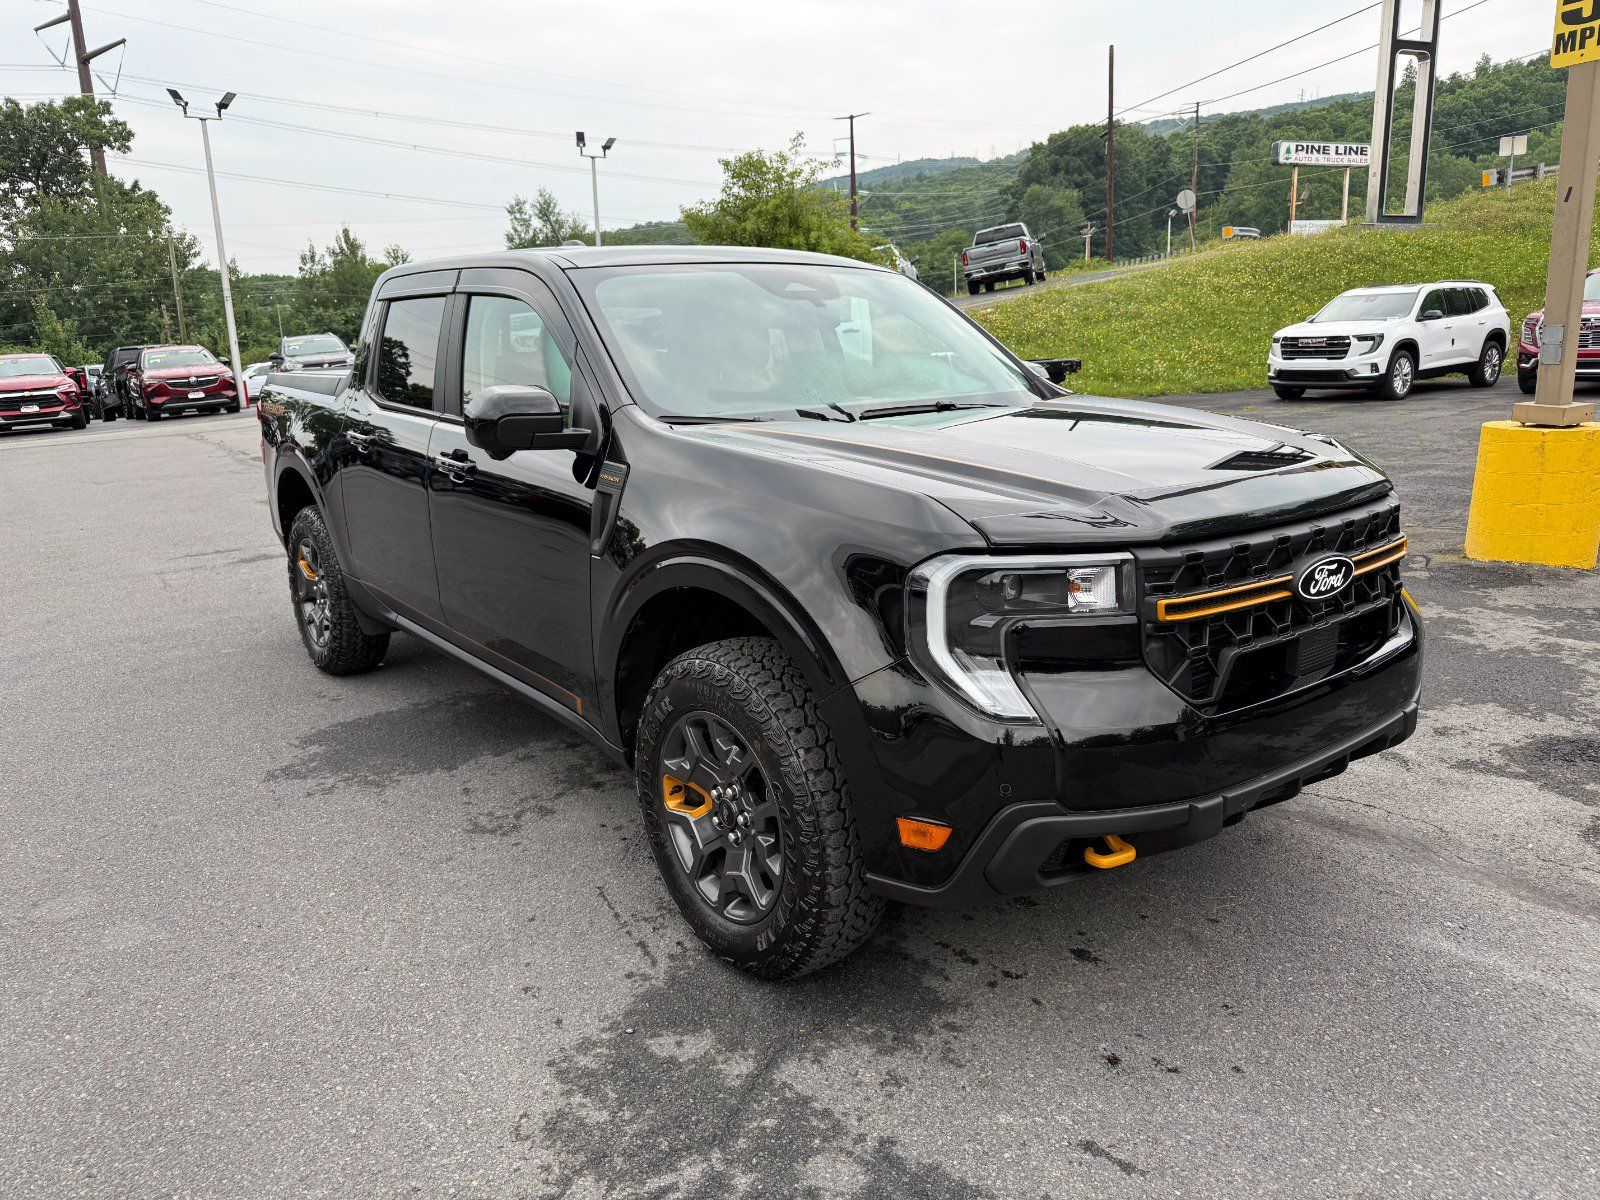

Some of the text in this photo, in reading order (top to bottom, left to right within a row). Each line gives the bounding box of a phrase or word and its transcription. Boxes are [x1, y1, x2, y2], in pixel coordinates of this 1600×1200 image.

[1554, 24, 1600, 55] MP
[1295, 144, 1368, 156] PINE LINE
[1310, 563, 1346, 595] Ford
